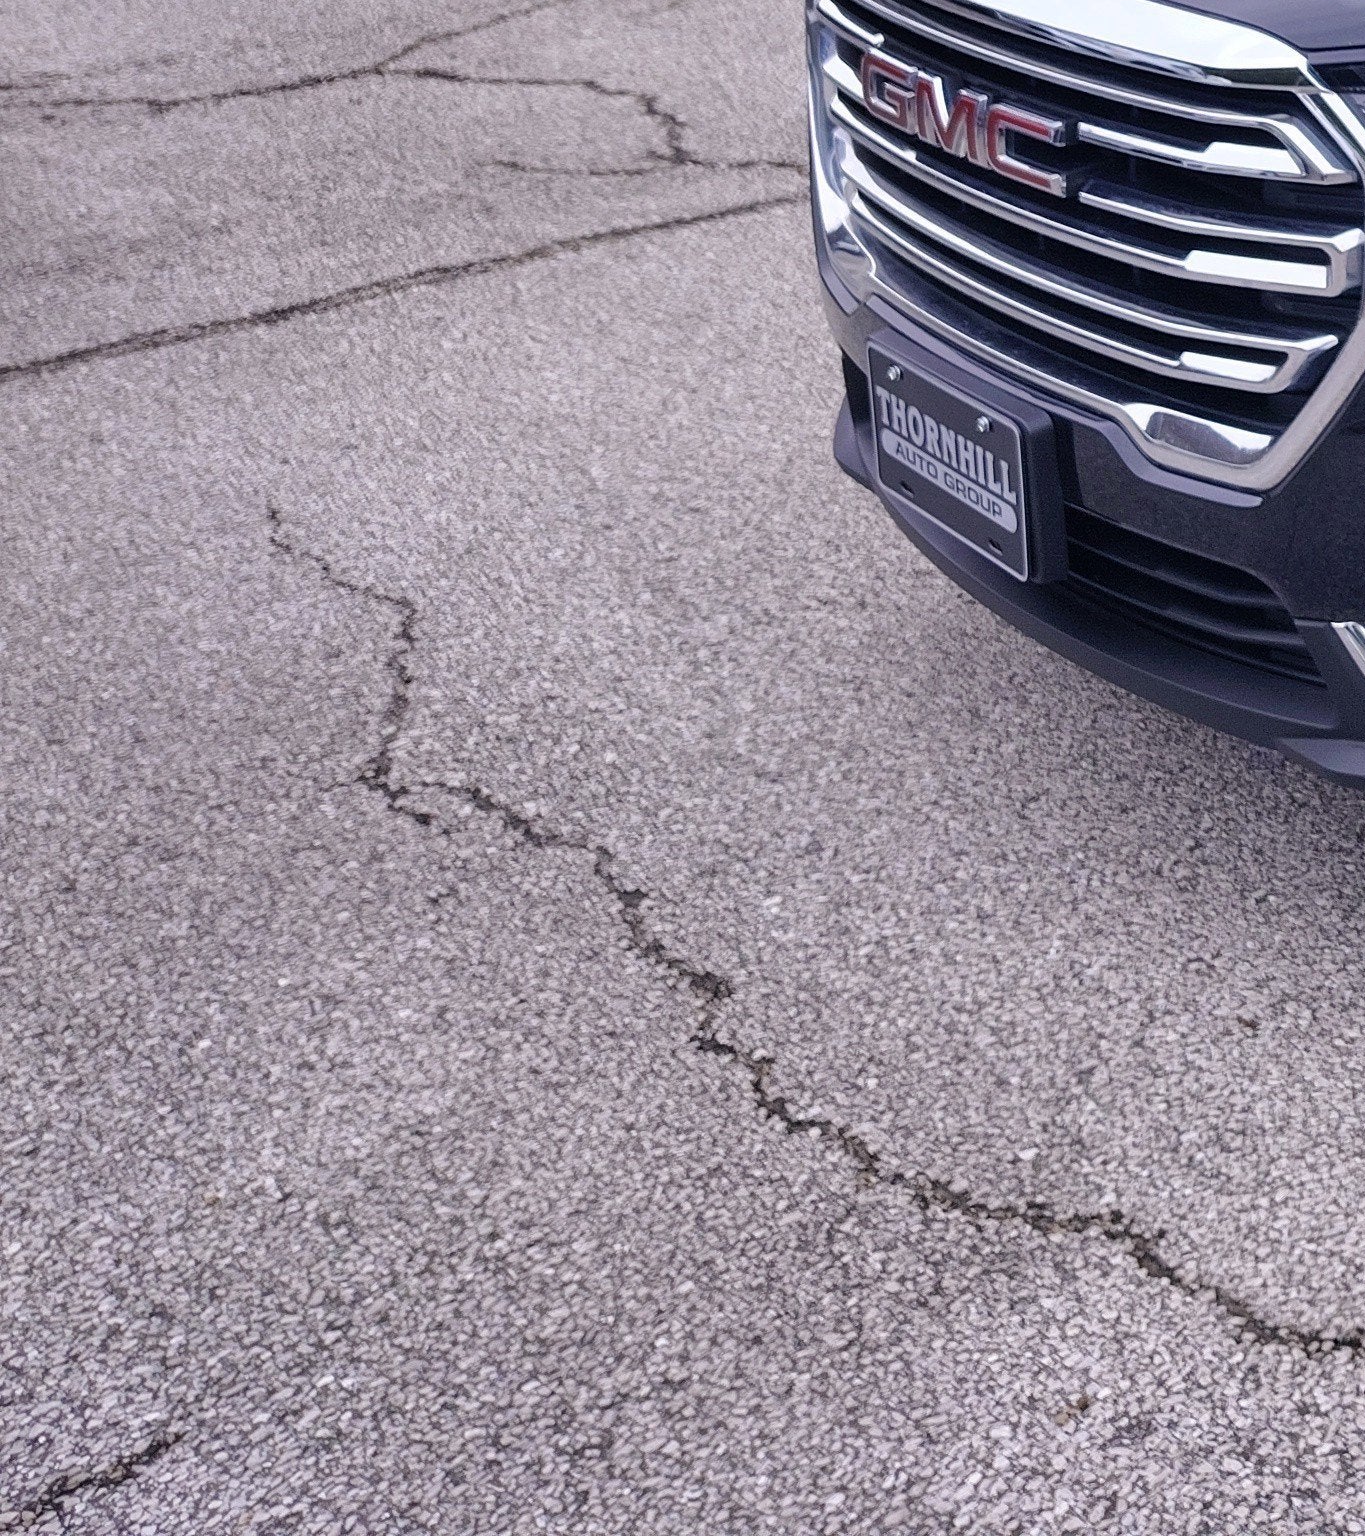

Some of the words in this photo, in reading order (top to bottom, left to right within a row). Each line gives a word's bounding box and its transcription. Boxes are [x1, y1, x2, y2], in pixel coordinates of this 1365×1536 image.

[861, 47, 1067, 198] GMC
[875, 385, 1017, 506] THORNHILL
[895, 440, 938, 480] AUTO
[944, 470, 1003, 517] GROUP
